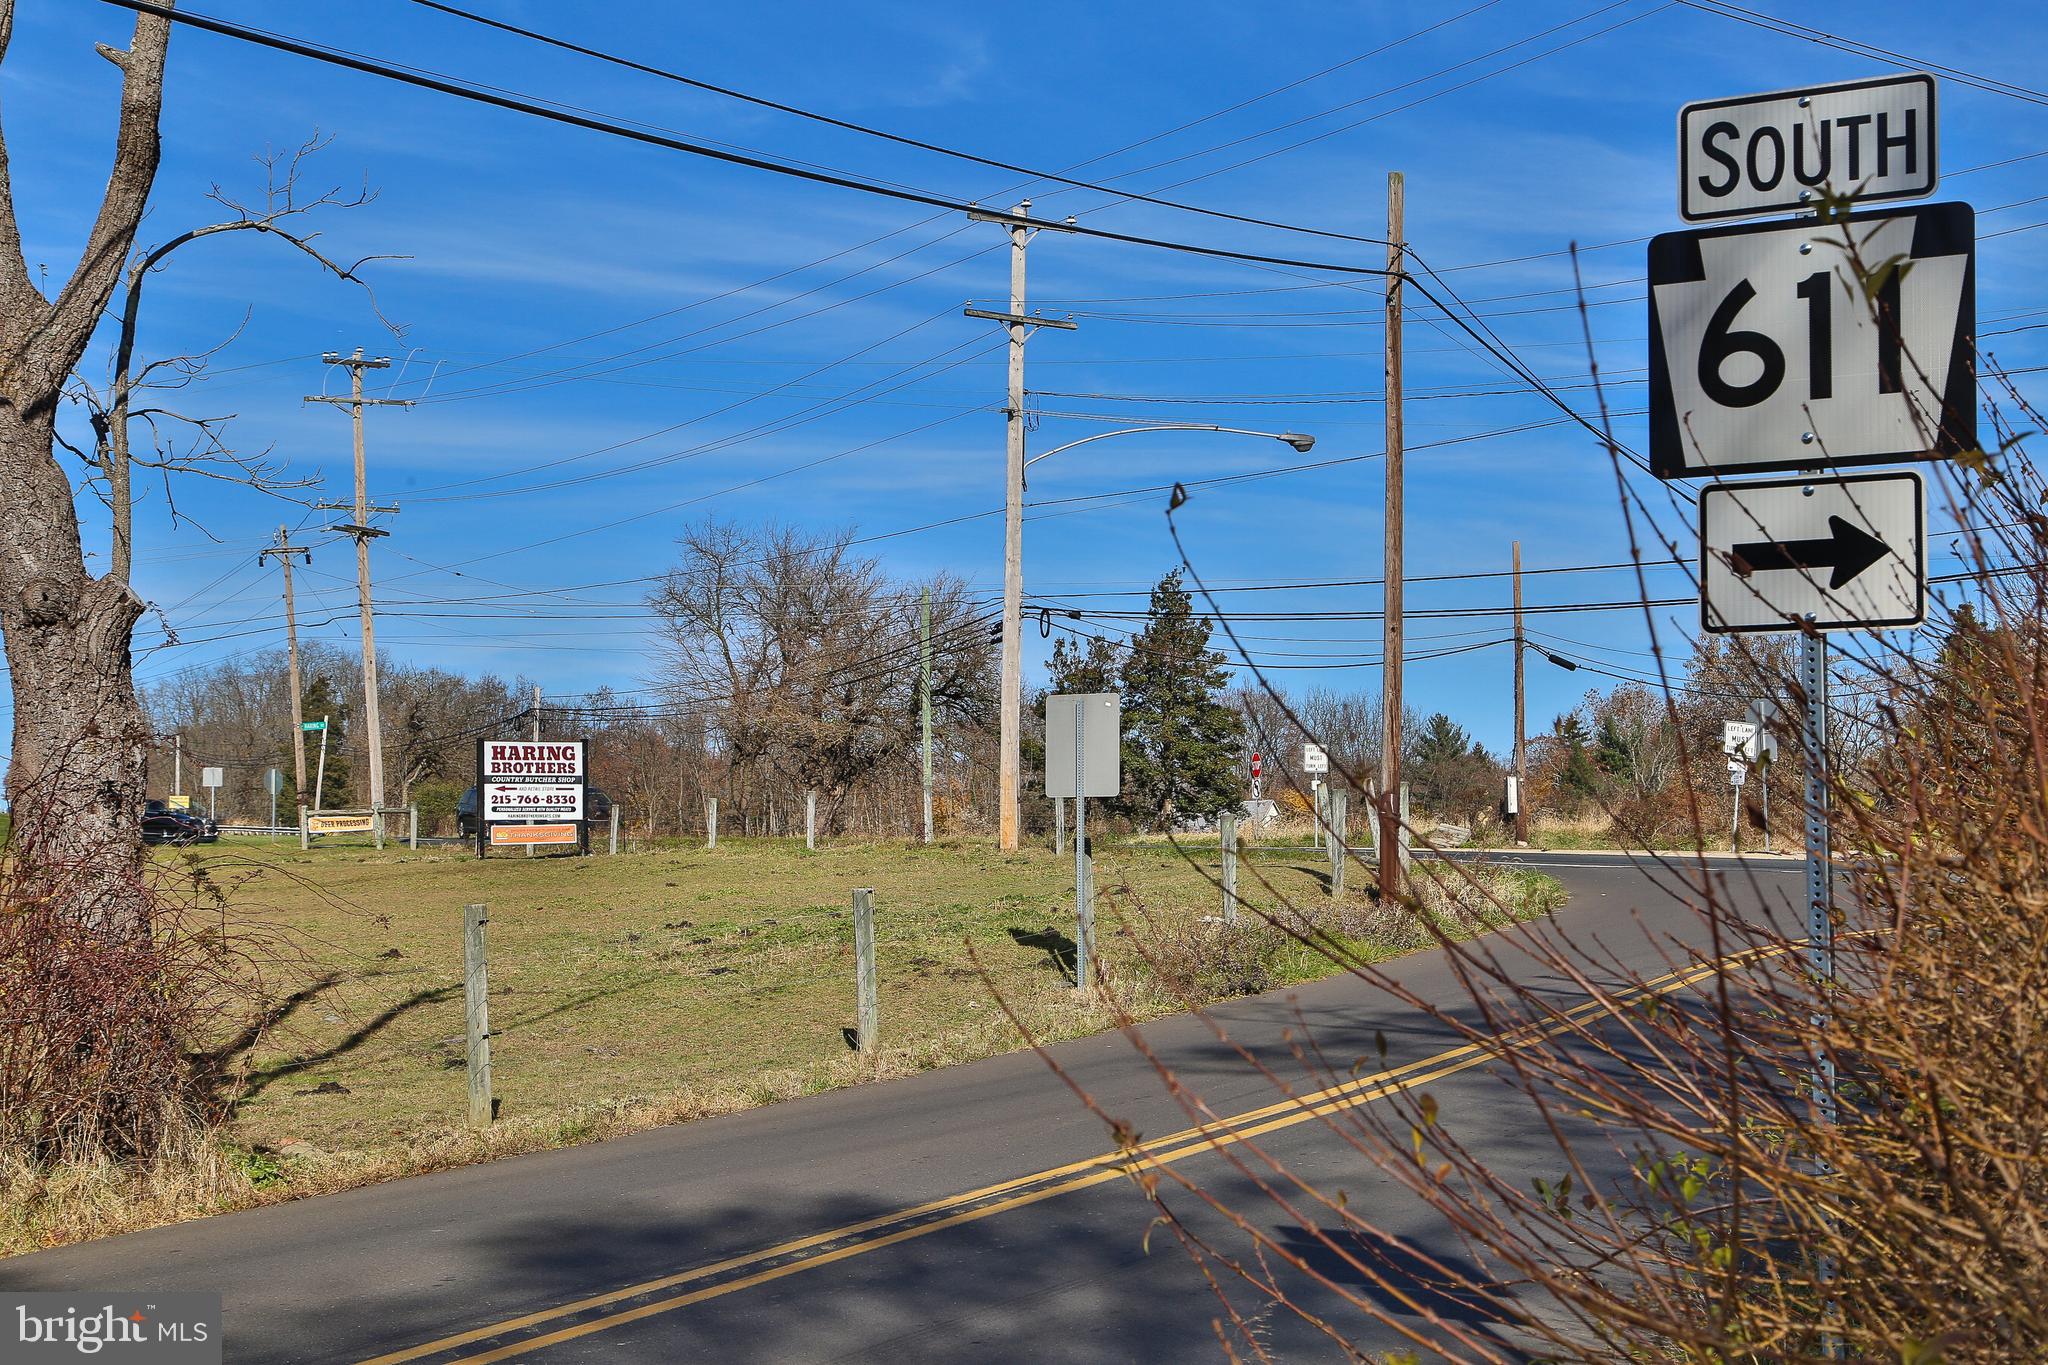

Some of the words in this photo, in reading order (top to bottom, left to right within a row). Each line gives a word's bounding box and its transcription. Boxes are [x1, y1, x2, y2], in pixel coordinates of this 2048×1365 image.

[1698, 108, 1917, 198] SOUTH
[1698, 263, 1902, 408] 611
[1731, 735, 1748, 743] MUST
[491, 745, 576, 761] HARING
[491, 762, 576, 774] BROTHERS
[491, 794, 576, 805] 215-766-8330
[320, 820, 335, 828] DEER
[336, 818, 370, 827] PROCESSING
[510, 831, 575, 839] THANKSGIVING
